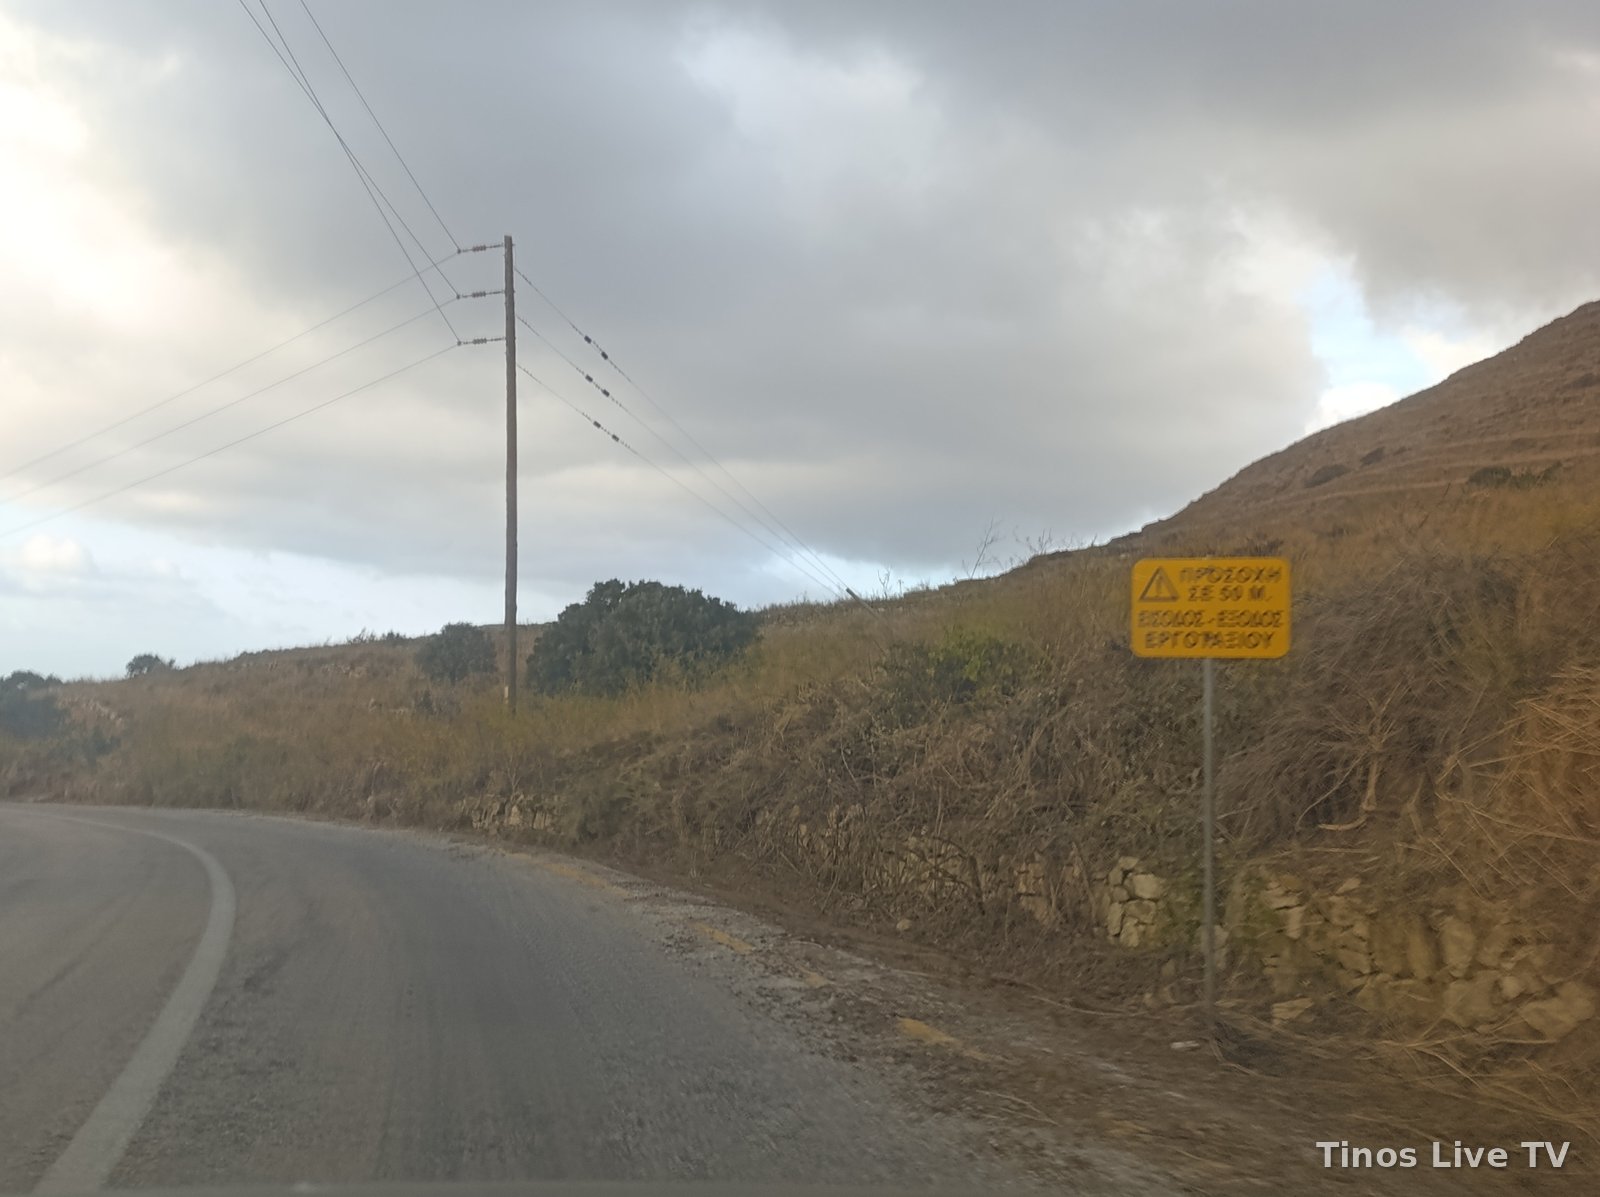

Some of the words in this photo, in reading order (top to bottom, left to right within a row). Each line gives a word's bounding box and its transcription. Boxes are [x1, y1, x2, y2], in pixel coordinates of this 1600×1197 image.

[1180, 566, 1281, 583] ΠΡΟΣΟΧΗ
[1188, 585, 1214, 601] ΣΕ
[1216, 610, 1284, 628] ΕΞΟΔΟΣ
[1145, 631, 1276, 649] ΕΡΓΟΤΑΞΙΟΥ
